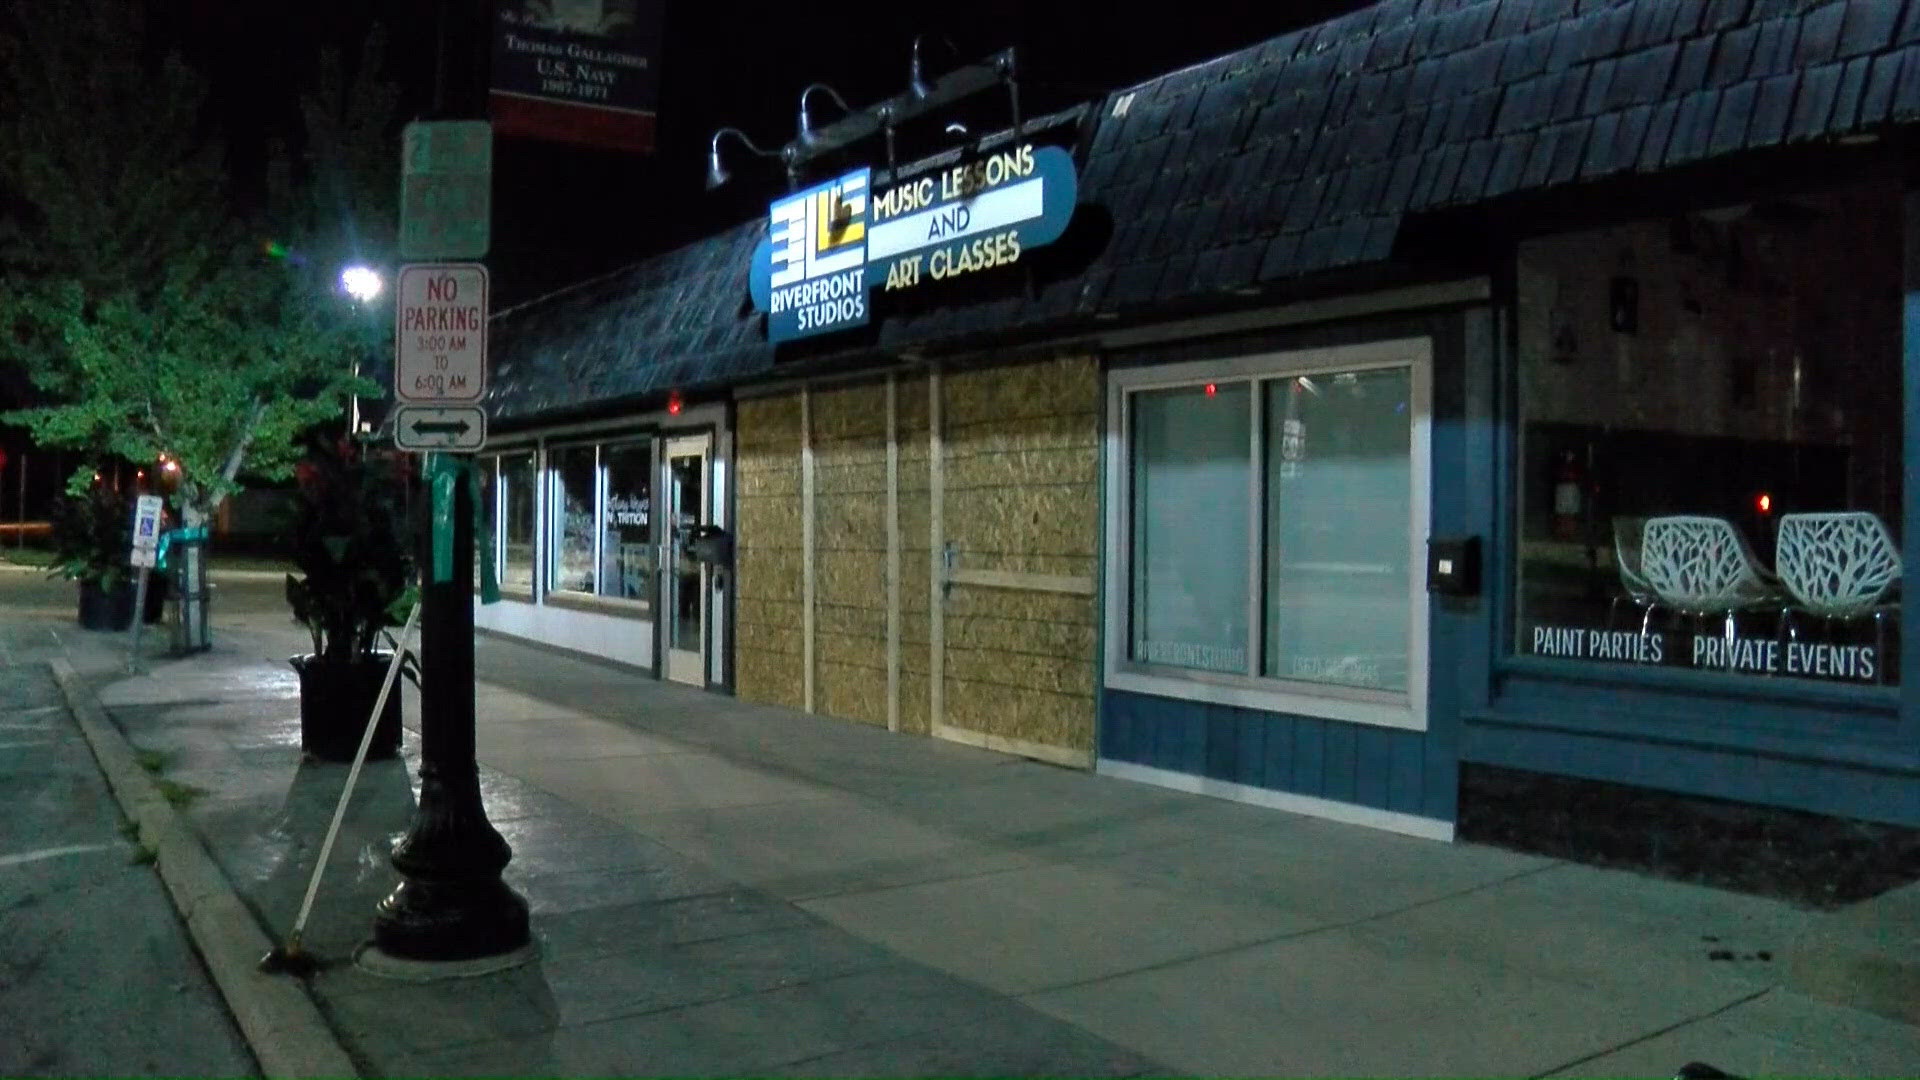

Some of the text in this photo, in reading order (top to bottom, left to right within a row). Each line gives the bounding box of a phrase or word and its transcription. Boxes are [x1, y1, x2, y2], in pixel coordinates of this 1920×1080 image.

[873, 143, 1035, 222] MUSIC LESSONS
[927, 205, 971, 241] AND
[884, 229, 1021, 292] ART CLASSES
[427, 276, 458, 301] NO
[770, 268, 865, 314] RIVERFRONT
[405, 306, 479, 331] PARKING
[797, 294, 865, 330] STUDIOS
[416, 335, 467, 351] 3:00 AM
[434, 355, 449, 370] TO
[415, 374, 467, 390] 6:00 AM
[1533, 626, 1874, 678] PAINT PARTIES PRIVATE EVENTS
